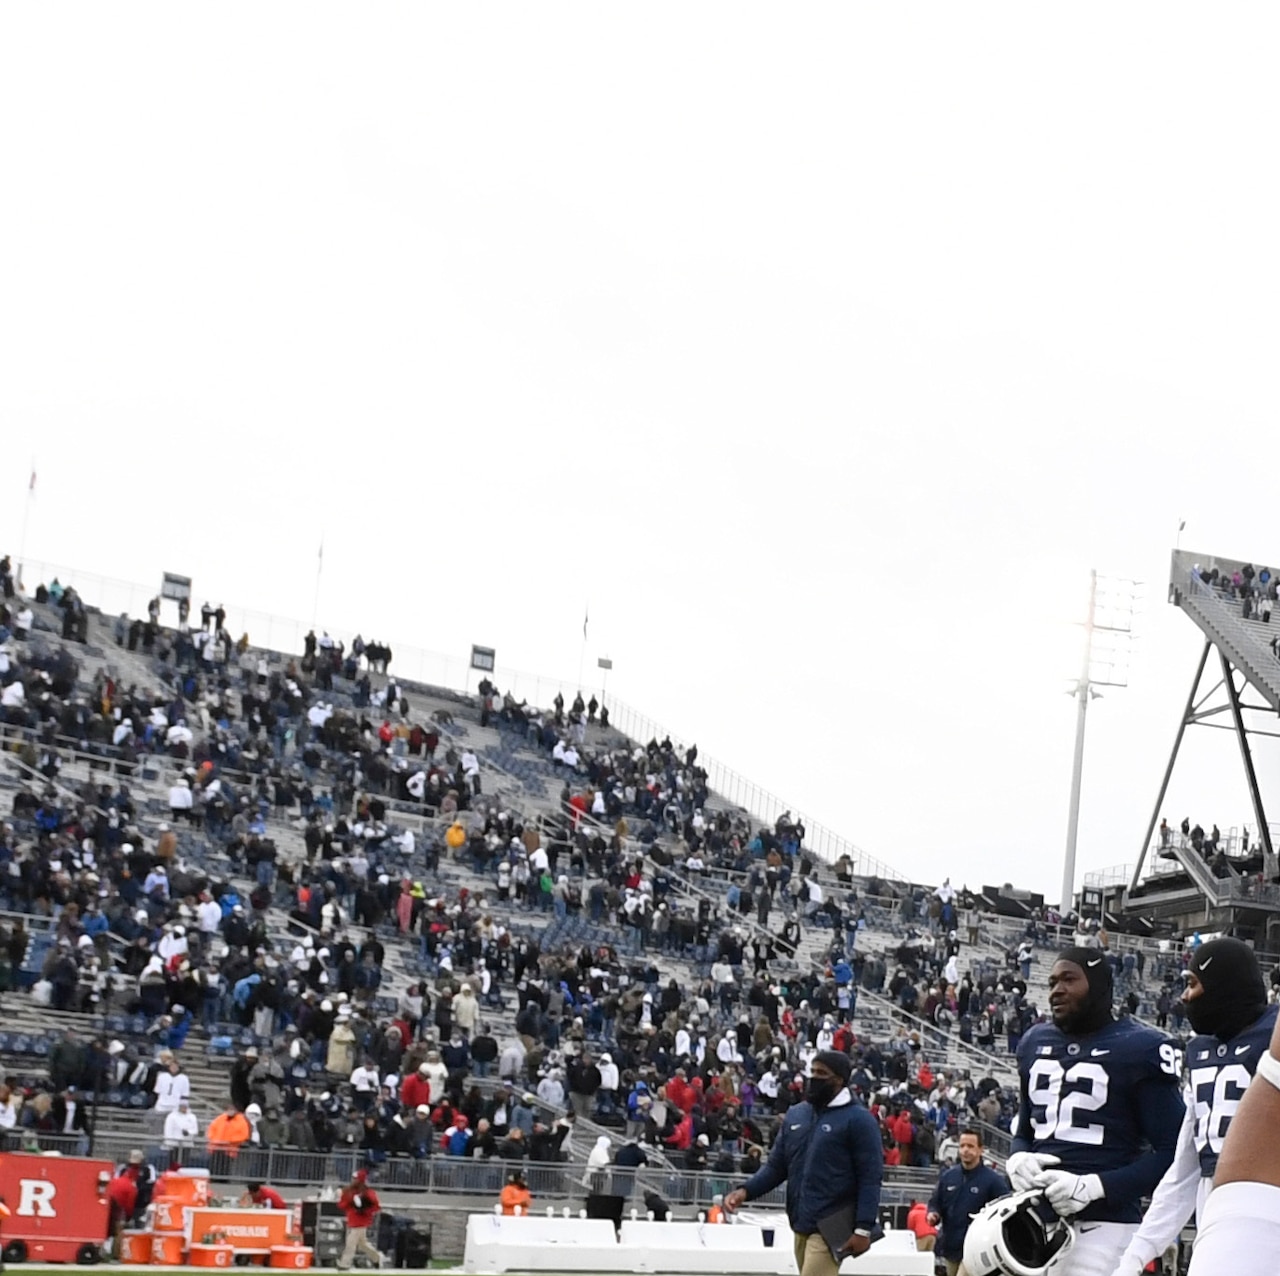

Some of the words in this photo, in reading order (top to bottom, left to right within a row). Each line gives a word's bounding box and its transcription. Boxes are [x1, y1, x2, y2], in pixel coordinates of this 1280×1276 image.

[1028, 1057, 1110, 1146] 92
[1190, 1063, 1253, 1154] 56
[15, 1178, 57, 1218] R
